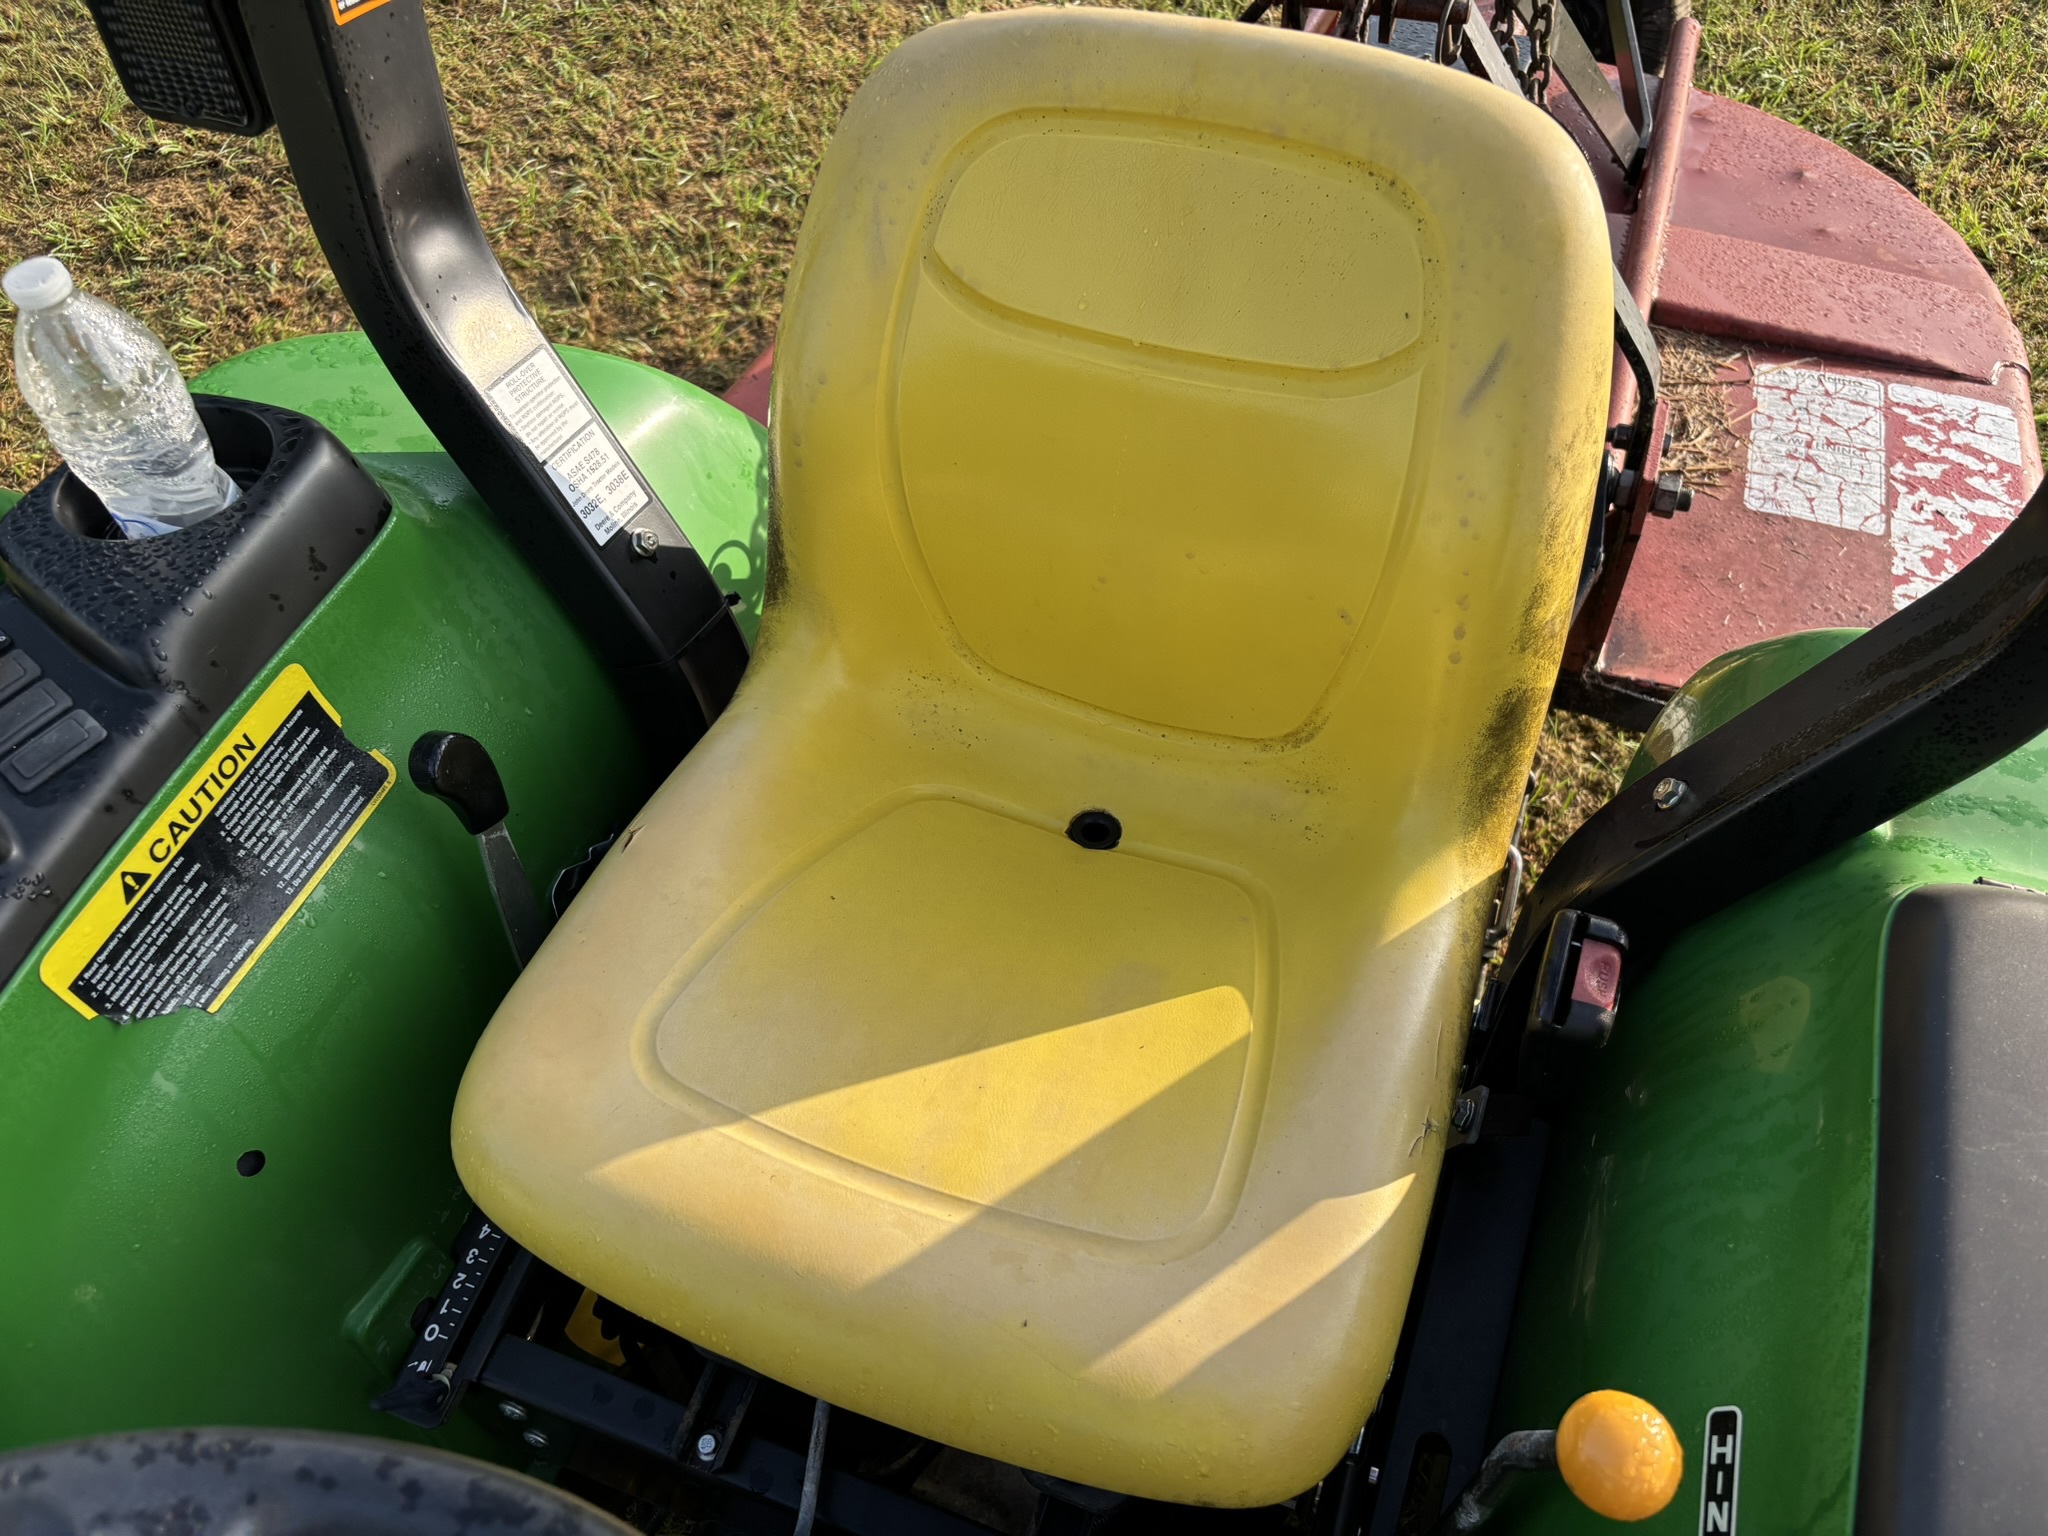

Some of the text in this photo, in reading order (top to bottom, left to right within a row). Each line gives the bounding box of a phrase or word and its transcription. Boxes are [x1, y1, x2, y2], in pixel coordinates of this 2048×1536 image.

[504, 361, 536, 389] ROLL-OVER
[508, 367, 542, 397] PROTECTIVE
[513, 375, 546, 403] STRUCTURE
[550, 427, 595, 471] CERTIFICATION
[565, 446, 600, 480] ASAE S478
[567, 471, 588, 493] OSHA
[571, 495, 582, 507] John
[580, 484, 593, 498] Deere
[591, 472, 606, 487] Tractor
[579, 469, 629, 520] 3032E, 3038E
[594, 513, 610, 531] Deere
[612, 488, 637, 514] Company
[620, 500, 638, 519] Illinois
[234, 707, 303, 792] brakes or operating around hazards
[145, 732, 259, 866] CAUTION
[219, 814, 228, 824] on
[225, 799, 241, 816] rough
[237, 781, 255, 801] ground
[252, 775, 259, 783] or
[257, 761, 271, 777] steep
[224, 810, 242, 831] Couple
[239, 795, 254, 812] brake
[251, 778, 268, 798] pedals
[264, 758, 284, 781] together
[281, 751, 289, 760] for
[286, 739, 299, 753] road
[231, 823, 242, 837] Use
[256, 783, 275, 806] warning
[271, 769, 286, 786] lights
[283, 762, 291, 772] on
[288, 742, 308, 765] highway
[304, 727, 320, 745] unless
[244, 834, 257, 850] Stop
[254, 817, 272, 837] engine
[279, 777, 304, 806] implement
[299, 771, 307, 779] to
[304, 754, 321, 774] ground
[317, 745, 328, 757] and
[251, 840, 265, 855] shift
[261, 835, 269, 843] to
[281, 811, 288, 820] or
[285, 803, 295, 813] set
[307, 763, 327, 785] securely
[323, 747, 339, 765] before
[237, 807, 267, 843] prohibited by
[266, 781, 337, 868] Wait for all movement to stop before
[283, 857, 304, 881] Remove
[300, 848, 311, 861] key
[310, 825, 329, 847] leaving
[324, 809, 341, 829] tractor
[292, 876, 301, 887] Do
[298, 867, 308, 879] not
[305, 849, 324, 871] operate
[319, 828, 339, 851] machine
[336, 812, 352, 830] unless
[82, 961, 99, 980] Read
[96, 931, 124, 964] Operator's
[119, 909, 140, 934] Manual
[137, 891, 155, 912] before
[152, 865, 177, 895] operating
[173, 854, 184, 868] this
[96, 979, 107, 991] Do
[103, 968, 115, 982] not
[112, 947, 133, 972] operate
[129, 922, 152, 949] machine
[148, 901, 169, 925] without
[181, 860, 201, 884] shields
[127, 959, 145, 980] towed
[154, 930, 169, 947] only
[164, 924, 173, 934] to
[169, 902, 191, 927] drawbar
[187, 895, 196, 905] to
[192, 880, 208, 898] avoid
[103, 981, 116, 996] and
[113, 963, 131, 984] safety
[127, 942, 148, 966] devices
[144, 935, 153, 944] in
[150, 919, 166, 938] place
[162, 908, 175, 922] and
[124, 994, 142, 1014] Make
[137, 974, 157, 997] certain
[153, 951, 175, 977] children
[186, 916, 203, 936] others
[200, 906, 211, 919] are
[208, 892, 222, 909] clear
[219, 886, 228, 896] of
[134, 991, 157, 1019] machine
[153, 973, 171, 994] before
[167, 951, 188, 976] starting
[184, 933, 204, 955] engine
[200, 926, 208, 935] or
[153, 998, 163, 1010] all
[179, 955, 197, 977] tractor
[194, 944, 206, 958] and
[186, 971, 198, 984] and
[194, 949, 217, 975] clothing
[213, 935, 228, 953] away
[224, 921, 238, 938] from
[117, 978, 143, 1007] rearward
[466, 1248, 479, 1264] 3
[478, 1224, 491, 1239] 4
[440, 1299, 450, 1314] 1
[452, 1273, 467, 1289] 2
[424, 1324, 440, 1341] 0
